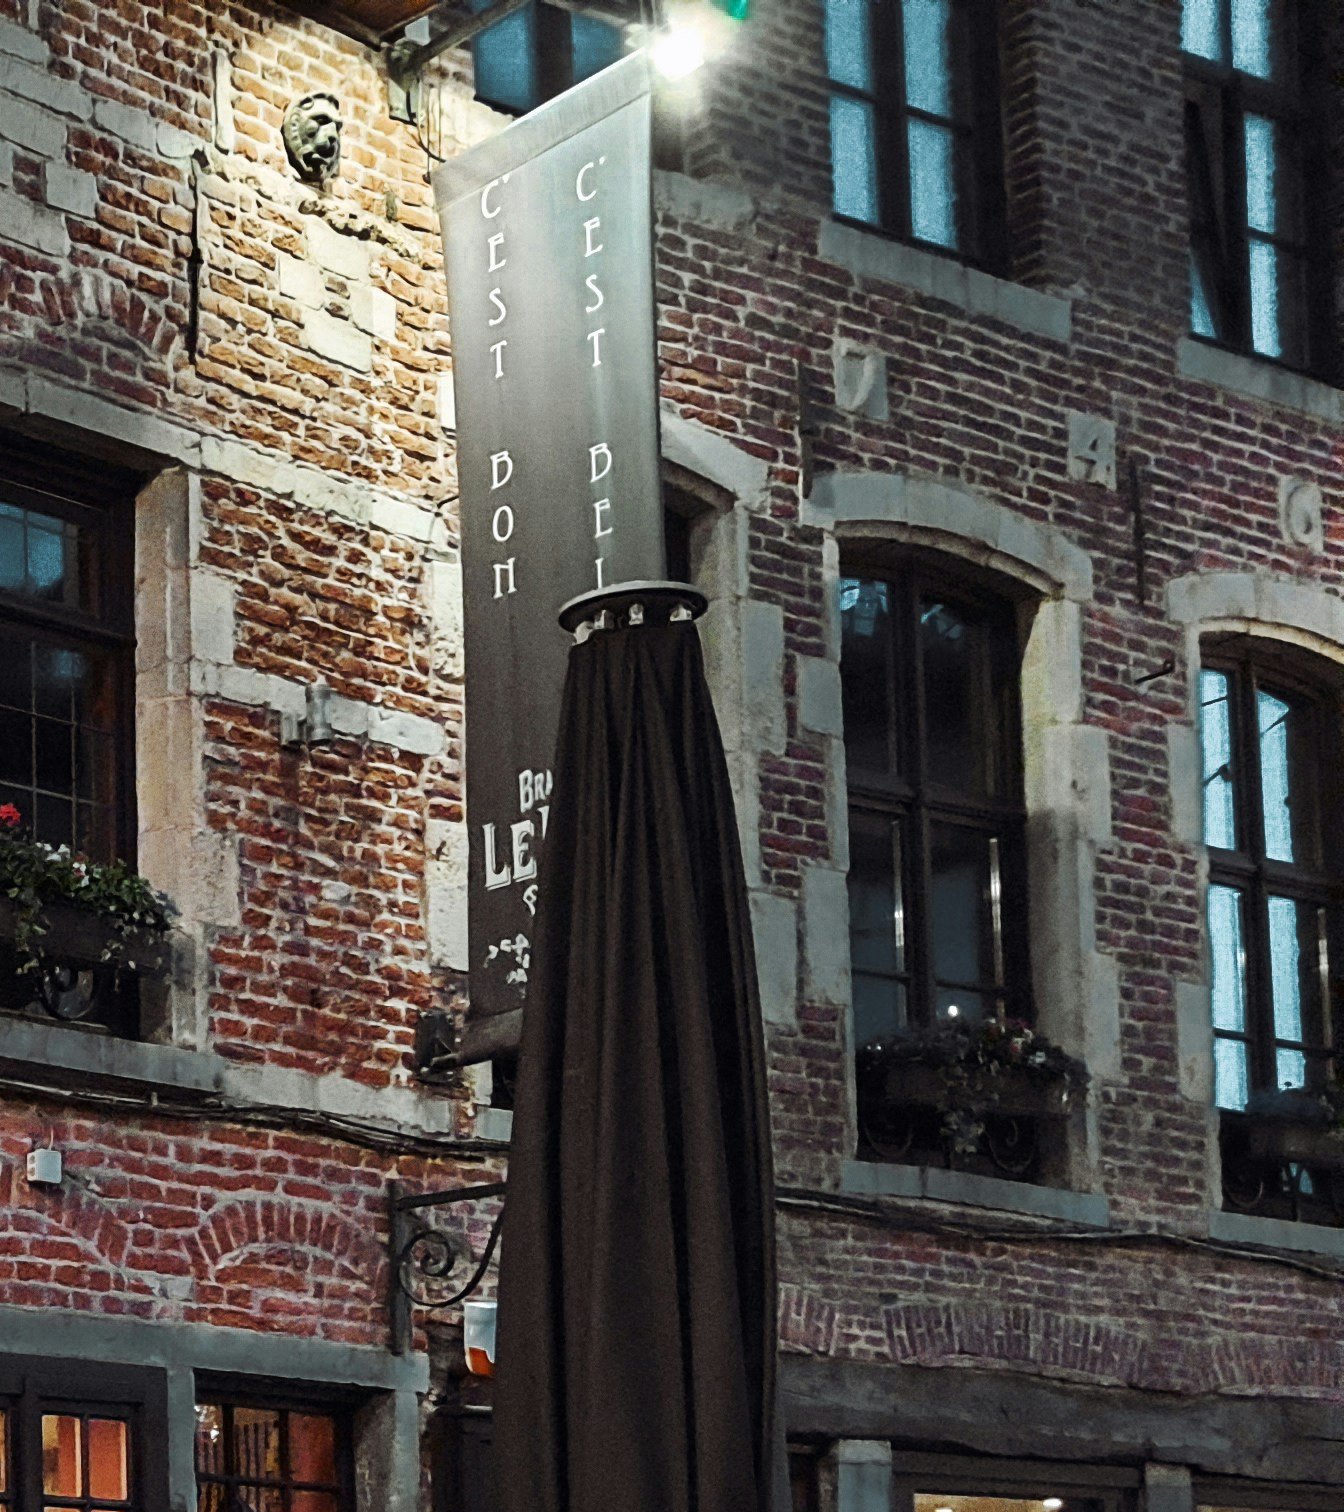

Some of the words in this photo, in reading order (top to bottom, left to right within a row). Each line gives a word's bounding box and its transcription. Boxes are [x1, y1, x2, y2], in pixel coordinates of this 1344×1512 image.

[481, 173, 511, 379] C'EST
[576, 155, 607, 367] C'EST
[490, 450, 517, 599] BON
